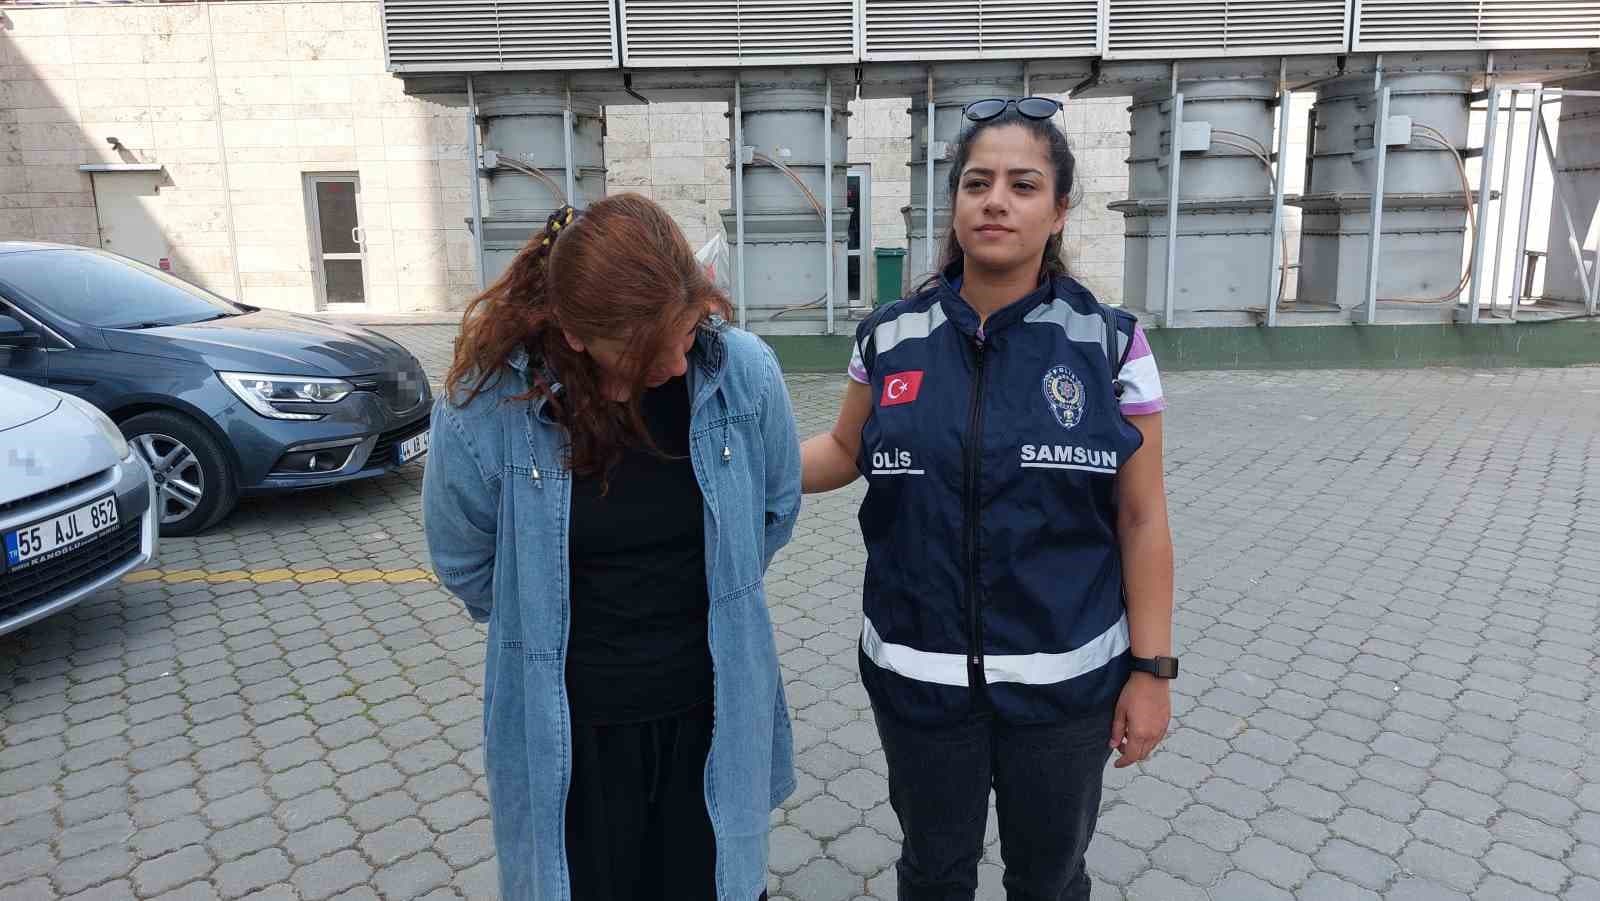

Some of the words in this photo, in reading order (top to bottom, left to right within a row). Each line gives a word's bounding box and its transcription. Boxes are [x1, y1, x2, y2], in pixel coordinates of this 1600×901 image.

[872, 447, 912, 468] OLİS
[1020, 444, 1117, 468] SAMSUN
[18, 527, 42, 556] 55
[55, 514, 84, 545] AJL
[90, 499, 117, 529] 852
